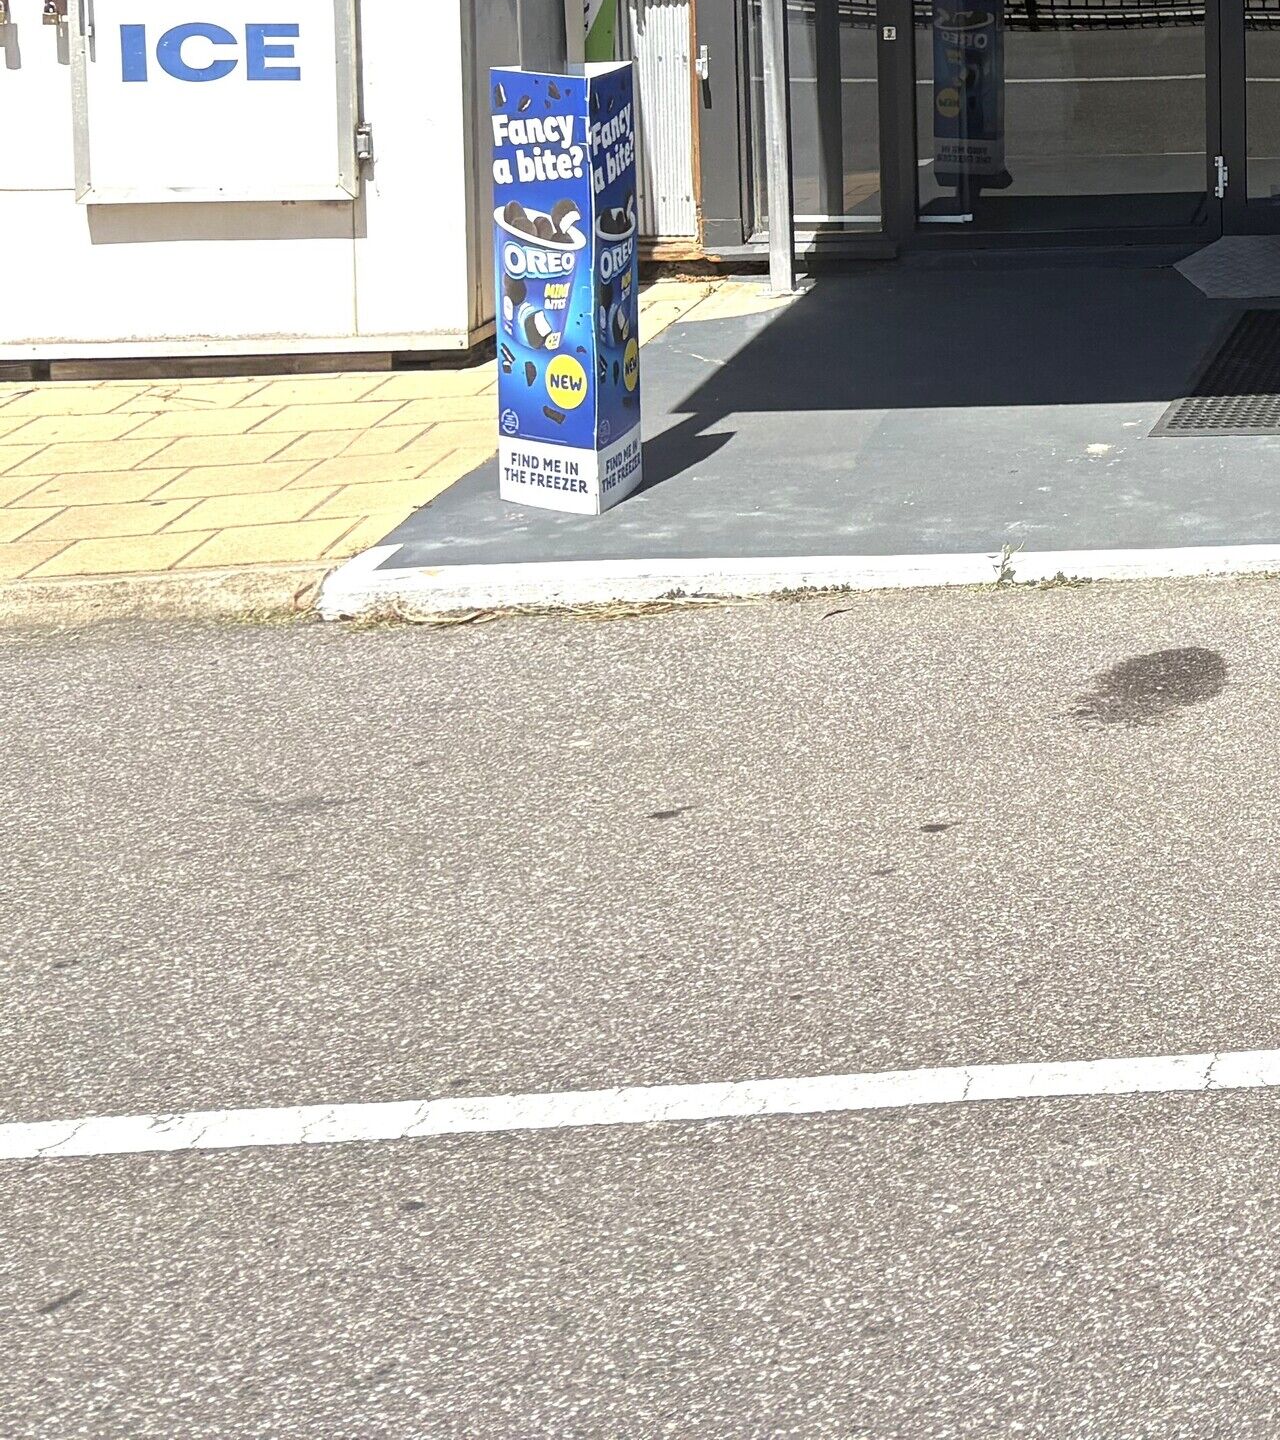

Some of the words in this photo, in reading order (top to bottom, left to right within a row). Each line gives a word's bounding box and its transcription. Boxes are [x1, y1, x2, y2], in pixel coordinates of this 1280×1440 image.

[119, 22, 301, 82] ICE
[492, 114, 573, 149] Fancy
[591, 103, 631, 156] Fancy
[493, 159, 513, 184] a
[516, 145, 584, 183] bite?
[593, 165, 605, 194] a
[606, 131, 635, 183] bite?
[504, 244, 575, 274] OREO
[600, 240, 633, 280] OREO
[550, 374, 582, 391] NEW
[511, 452, 539, 470] FIND
[543, 455, 561, 474] ME
[565, 459, 579, 476] IN
[602, 475, 617, 494] THE
[617, 452, 641, 486] FREEZER
[606, 452, 622, 474] FIND
[623, 444, 632, 462] ME
[504, 468, 527, 484] THE
[530, 472, 588, 494] FREEZER
